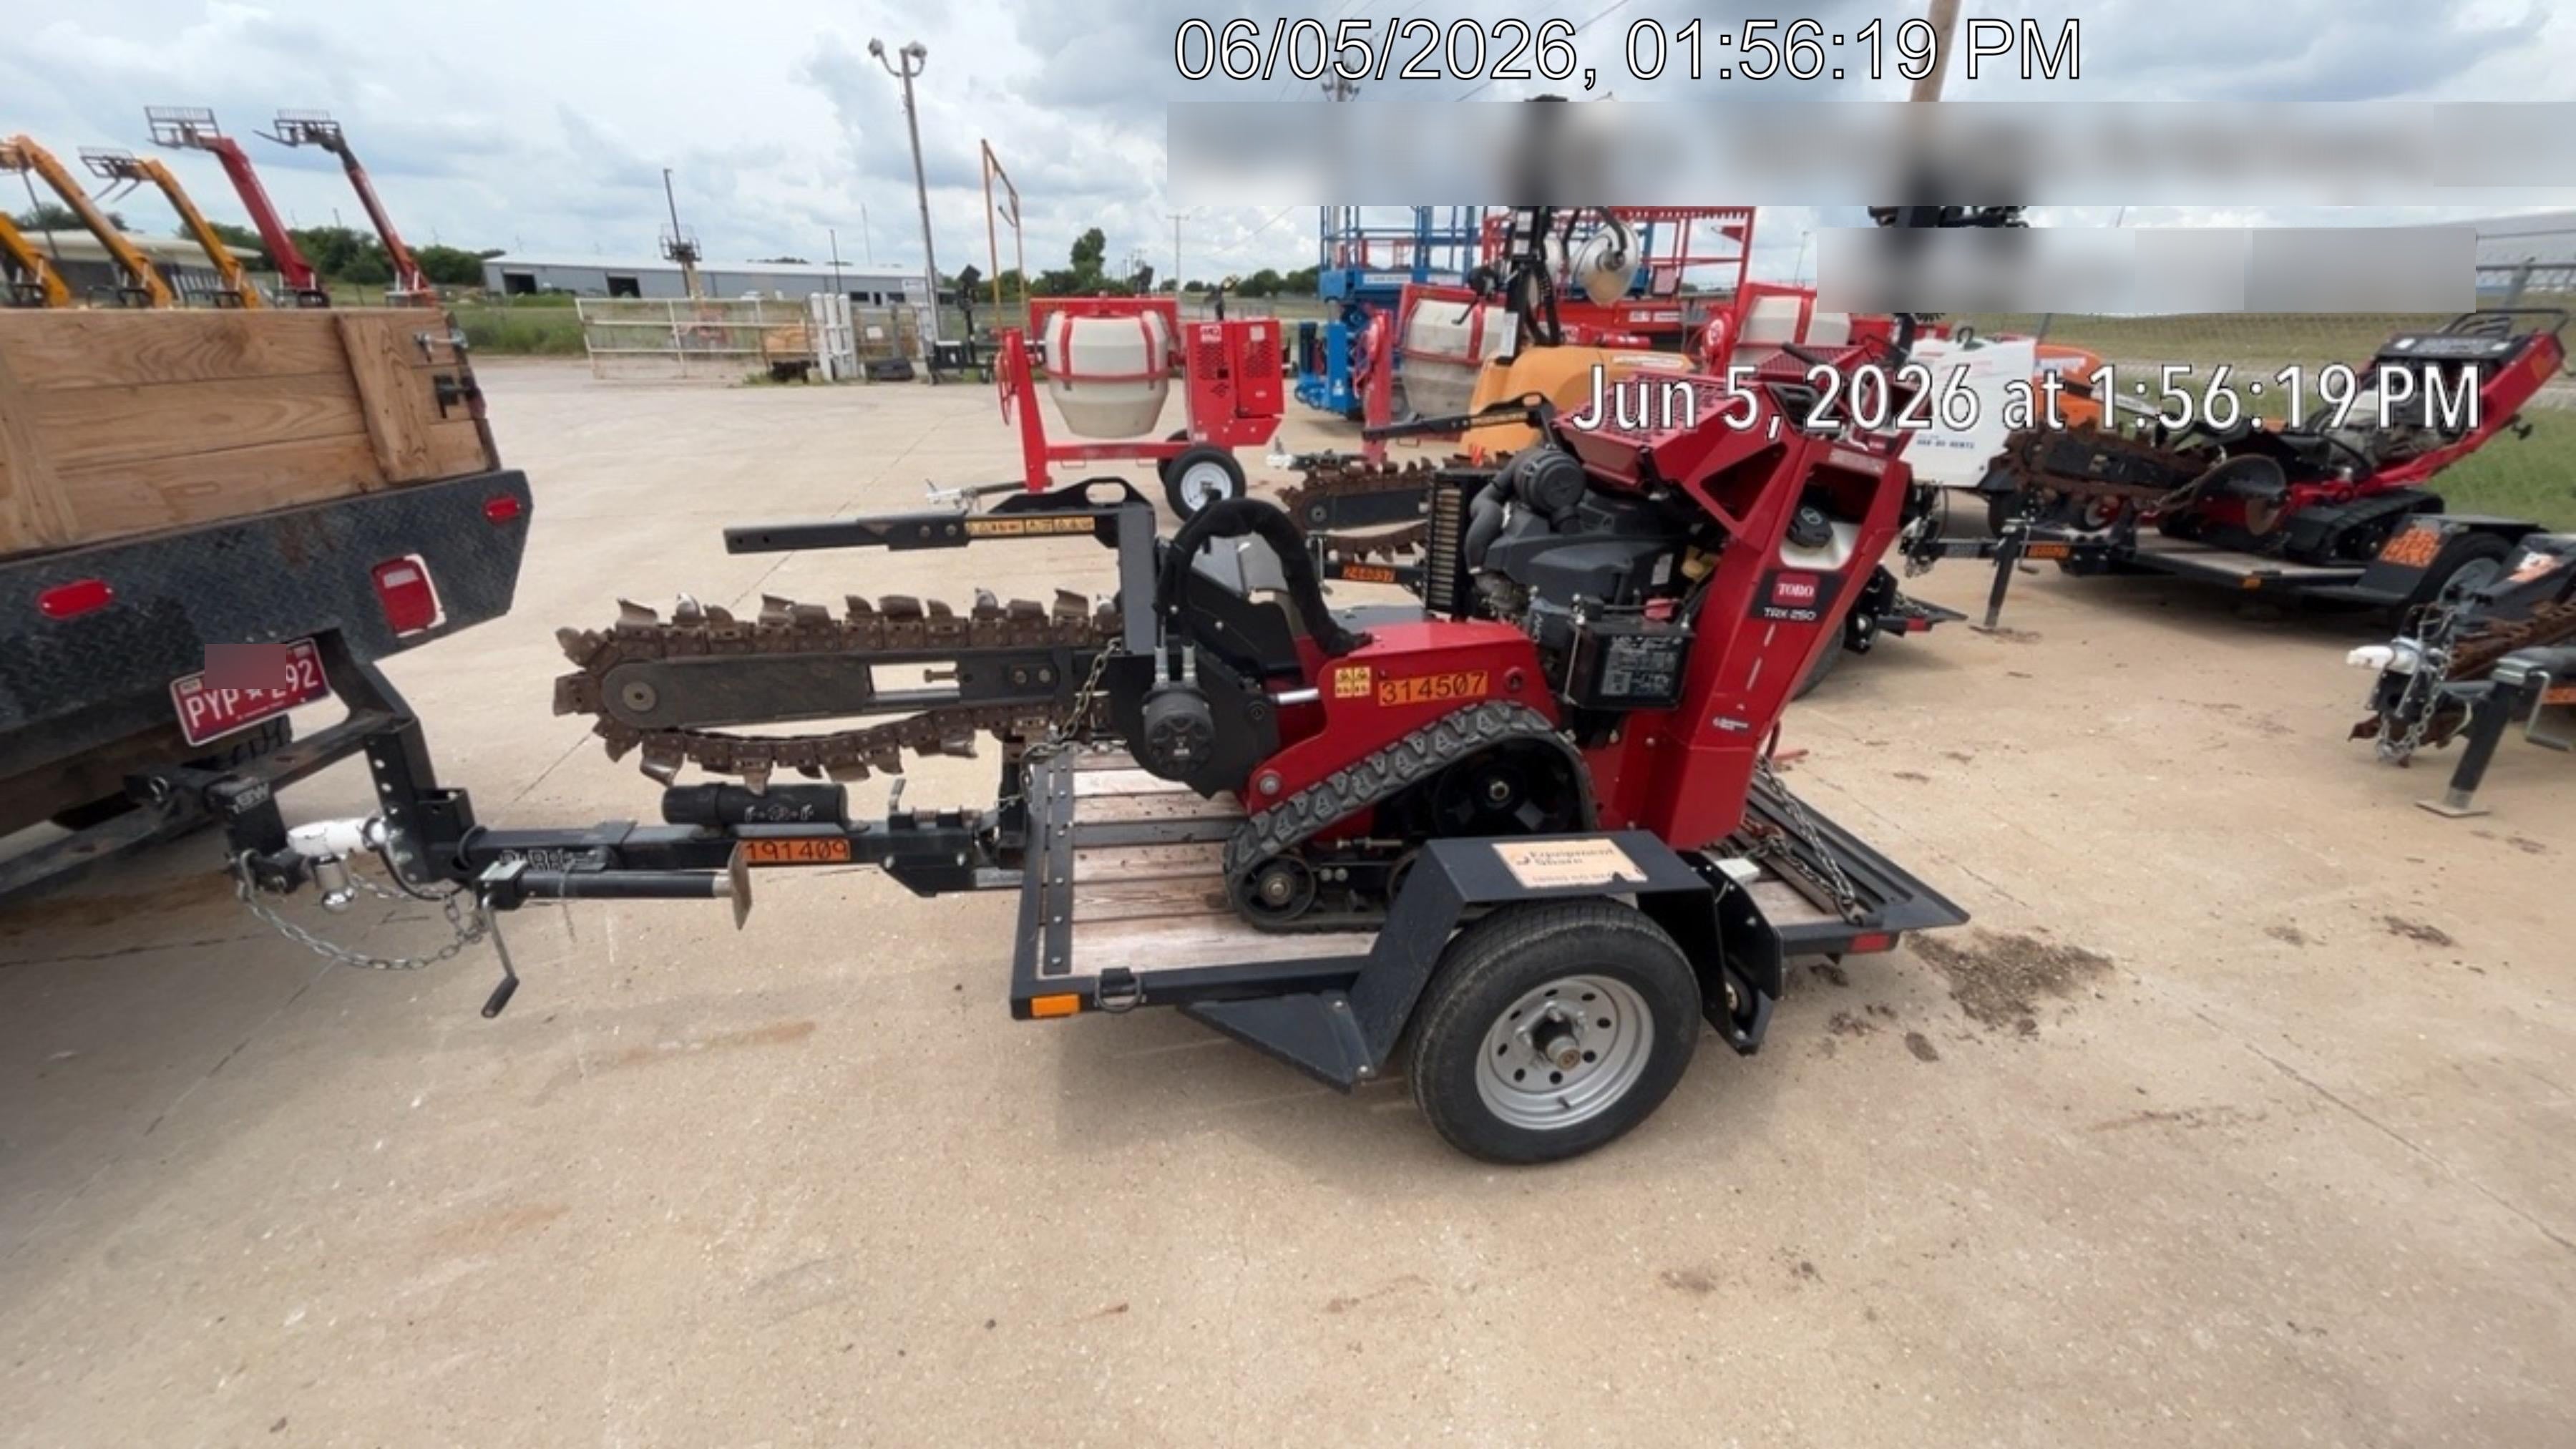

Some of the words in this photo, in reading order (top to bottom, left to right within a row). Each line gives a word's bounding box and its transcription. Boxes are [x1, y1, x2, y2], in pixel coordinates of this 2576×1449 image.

[1777, 583, 1815, 597] TORO
[1382, 672, 1485, 703] 314507
[185, 688, 238, 728] PYP
[746, 840, 847, 859] 191409
